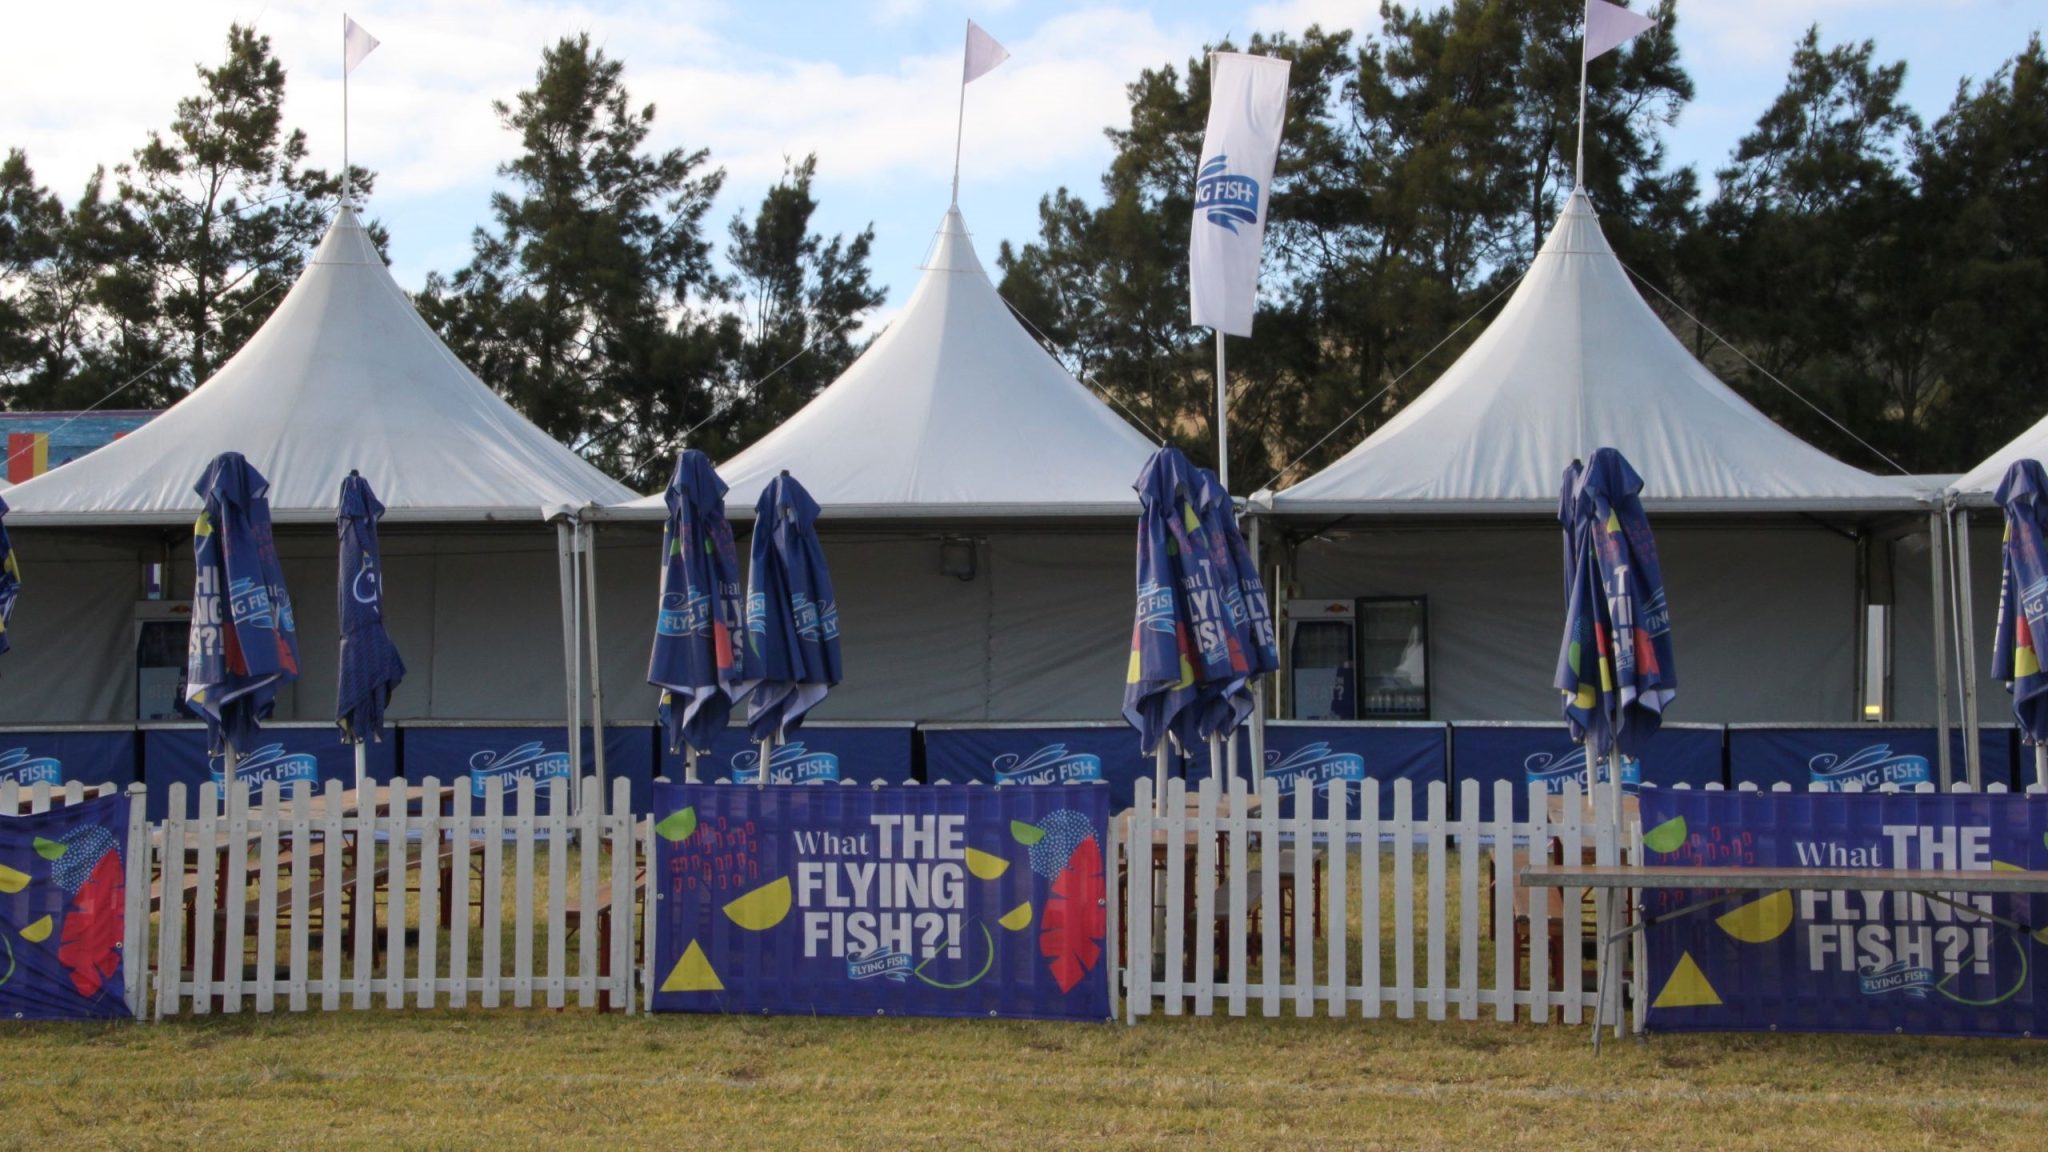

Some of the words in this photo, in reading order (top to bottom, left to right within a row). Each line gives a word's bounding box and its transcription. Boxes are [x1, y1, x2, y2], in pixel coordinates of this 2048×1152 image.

[1214, 181, 1254, 202] FISH
[19, 765, 56, 784] FISH
[276, 761, 312, 779] FISH
[535, 759, 570, 778] FISH
[797, 760, 833, 778] FISH
[1059, 761, 1096, 779] FISH
[1322, 761, 1359, 779] FISH
[1883, 763, 1924, 781] FISH
[793, 831, 869, 857] What
[870, 815, 965, 858] THE
[1796, 842, 1882, 867] What
[1883, 825, 1992, 871] THE
[798, 862, 965, 908] FLYING
[1800, 889, 1993, 923] FLYING
[804, 912, 962, 960] FISH?!
[1808, 924, 1990, 975] FISH?!
[851, 960, 884, 975] FLYING
[887, 956, 908, 968] FISH
[1864, 975, 1902, 989] FLYING
[1905, 971, 1929, 982] FISH
